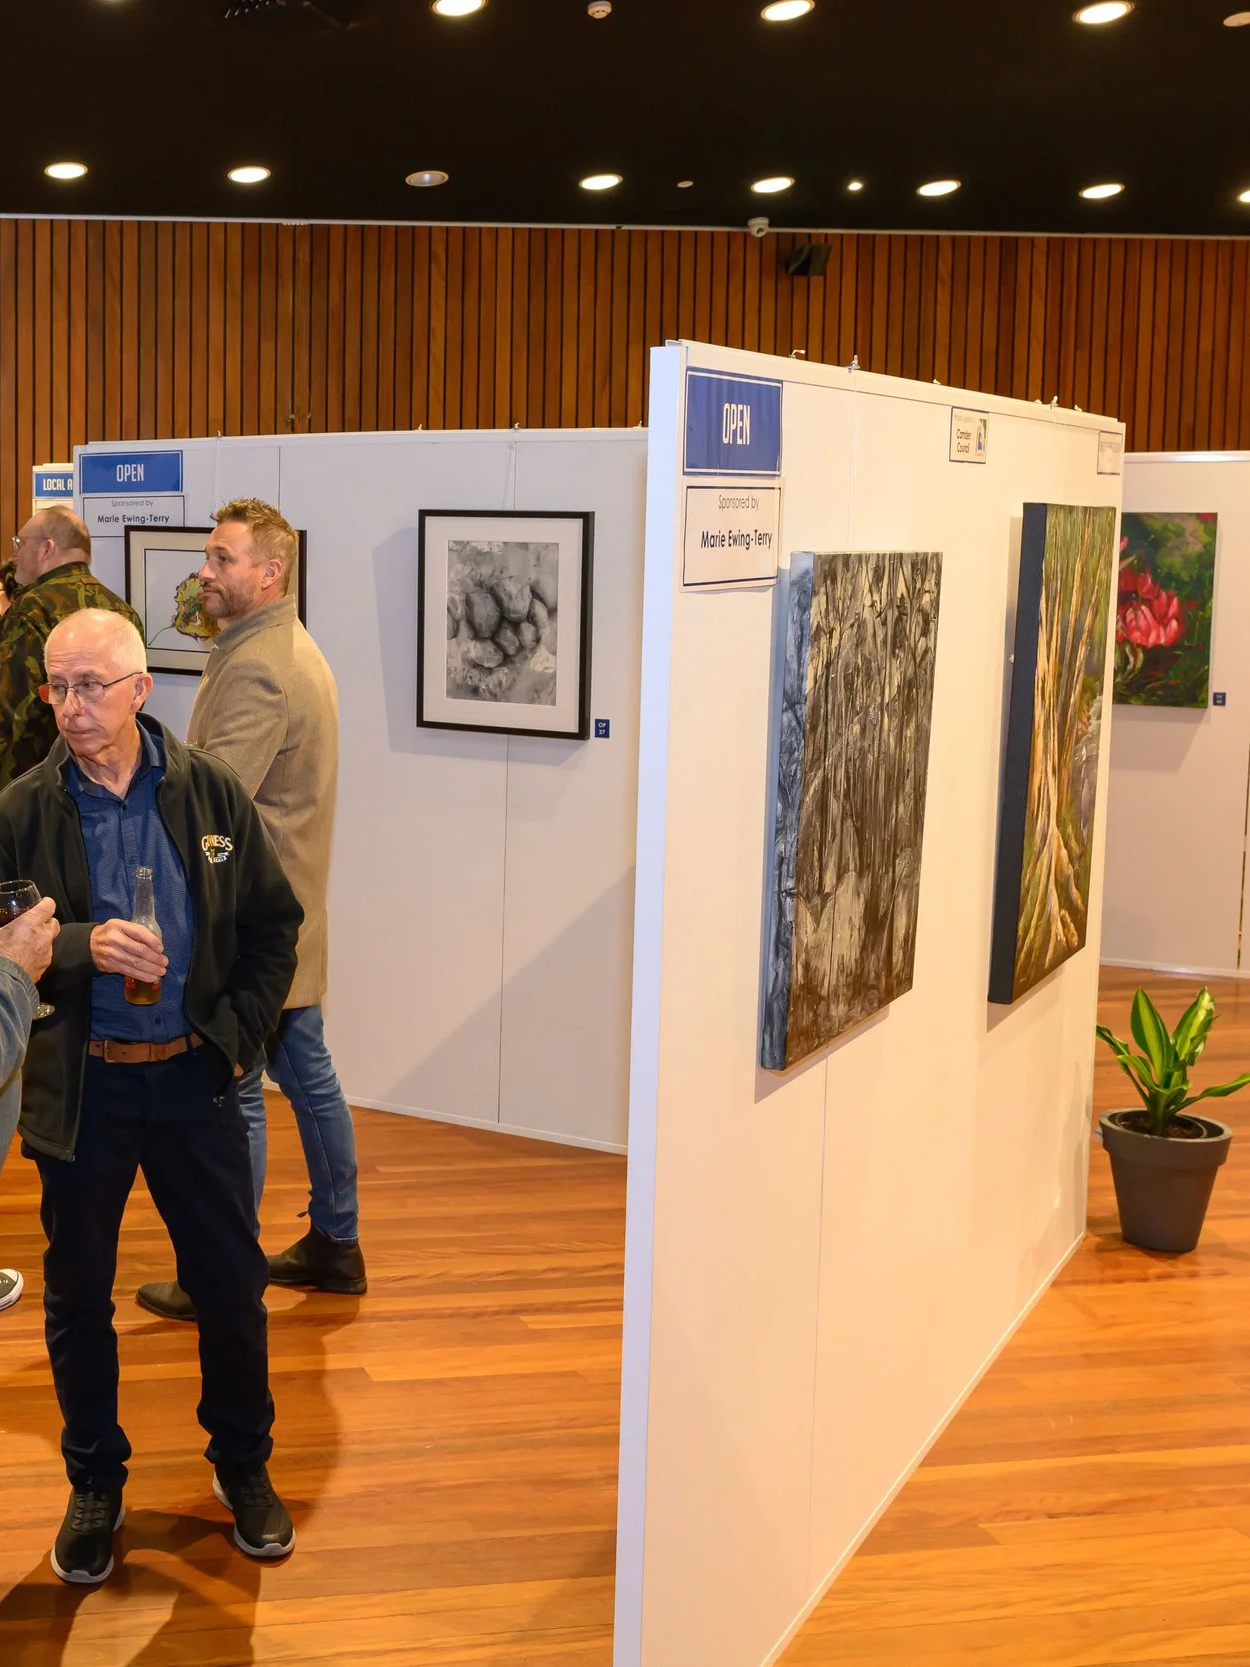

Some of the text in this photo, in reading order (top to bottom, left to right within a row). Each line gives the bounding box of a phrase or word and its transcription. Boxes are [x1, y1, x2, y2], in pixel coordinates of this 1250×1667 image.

[722, 402, 751, 445] OPEN
[116, 463, 144, 482] OPEN
[42, 478, 66, 491] LOCAL
[111, 499, 154, 508] Sponsored by
[718, 494, 760, 512] Sponsored by
[97, 514, 170, 524] Marie Ewing-Terry
[700, 529, 773, 551] Marie Ewing-Terry
